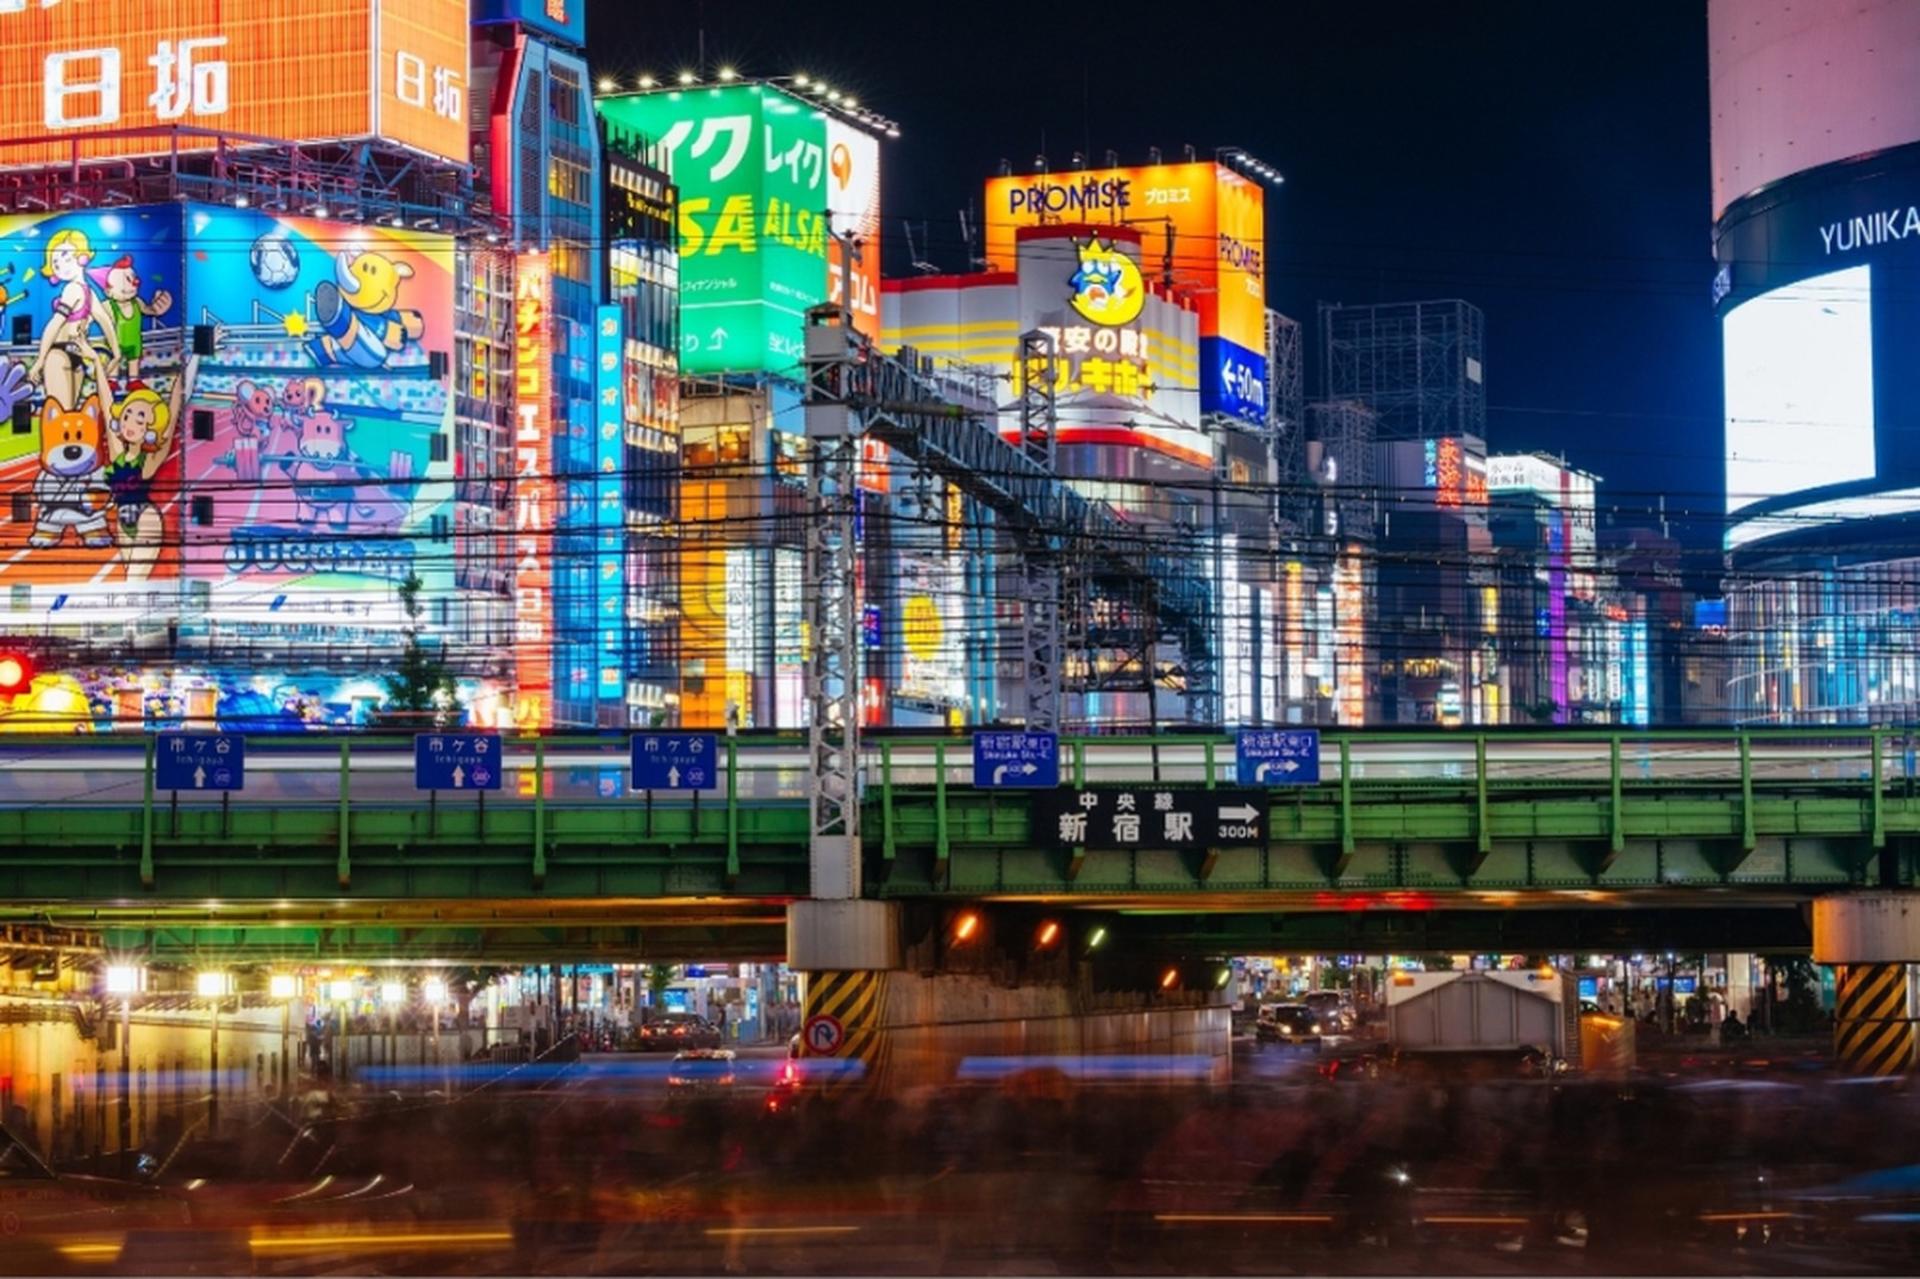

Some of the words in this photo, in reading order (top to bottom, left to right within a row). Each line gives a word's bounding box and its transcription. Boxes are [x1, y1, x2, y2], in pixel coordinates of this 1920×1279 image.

[44, 37, 228, 130] 日拓
[396, 50, 462, 121] 日拓
[764, 124, 823, 190] レイク
[1010, 180, 1131, 215] PROMISE
[1144, 187, 1192, 207] プロミス
[763, 197, 826, 259] ALSA
[516, 270, 542, 395] パチンコ
[1237, 363, 1264, 408] 50m
[1078, 791, 1175, 812] 中央線
[1058, 812, 1194, 843] 新宿駅
[1217, 825, 1260, 839] 300M
